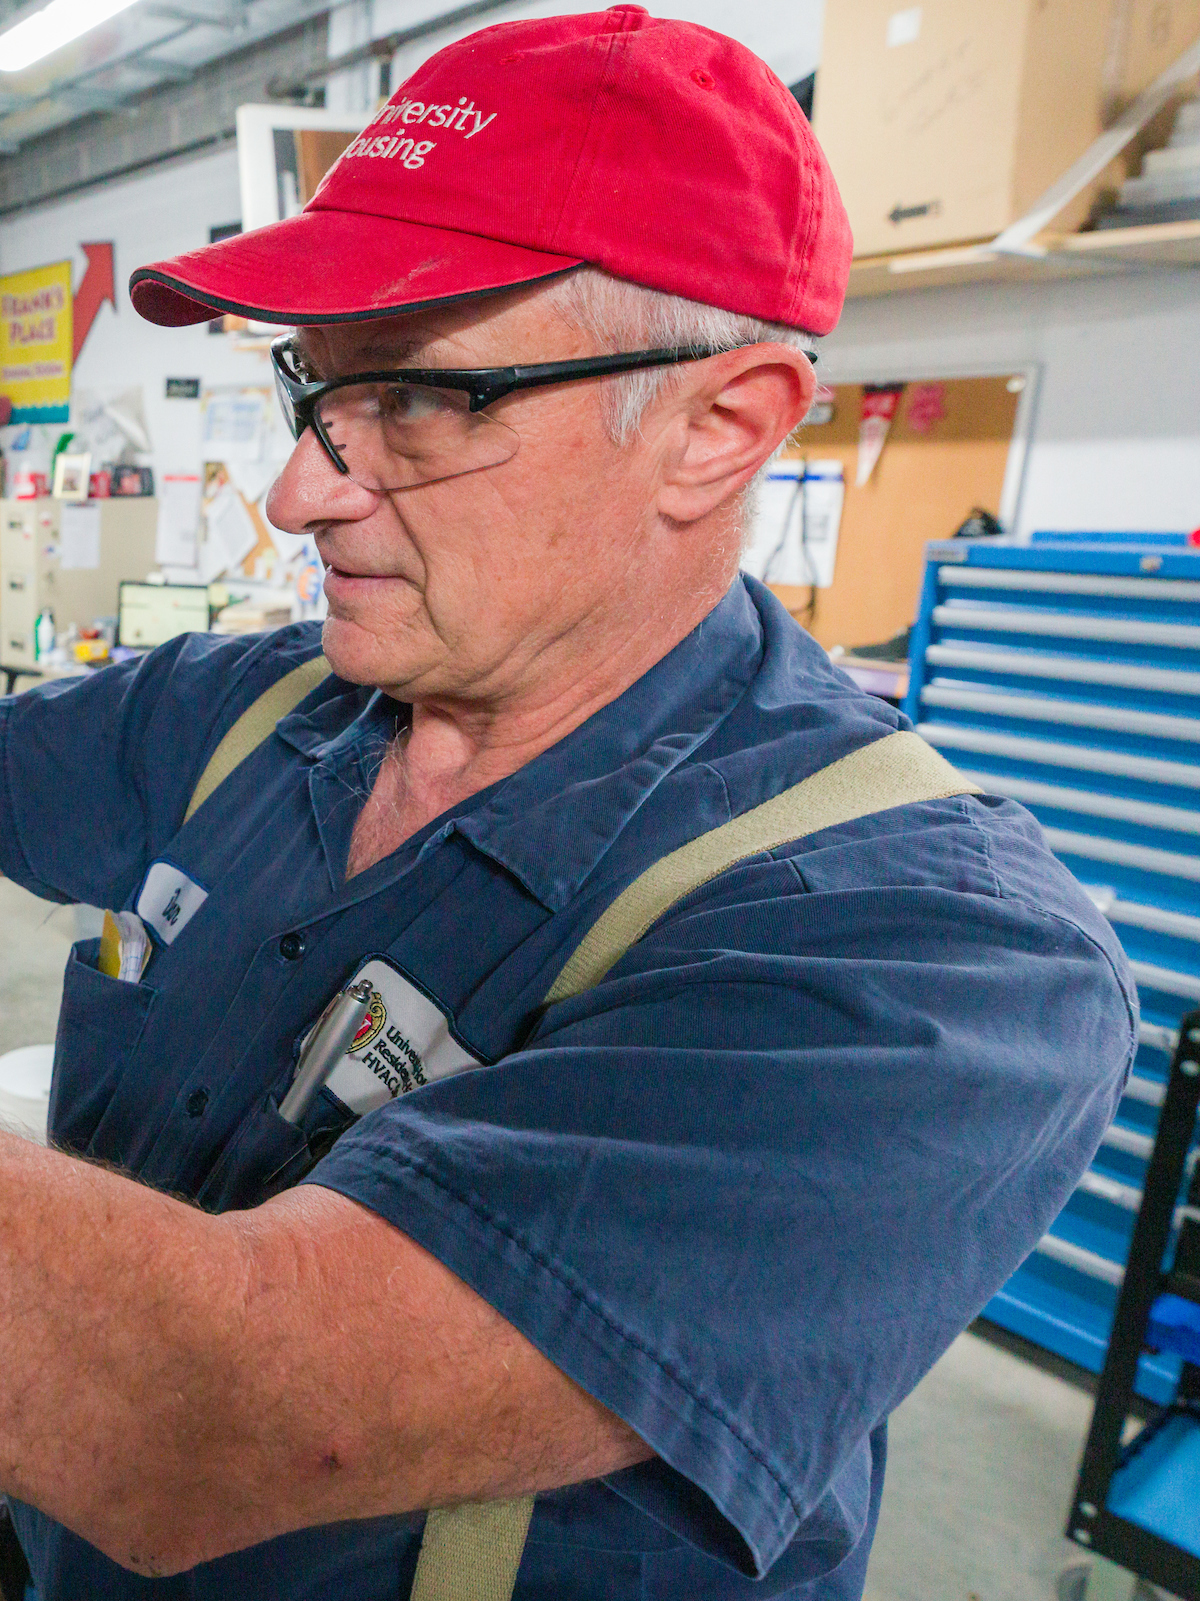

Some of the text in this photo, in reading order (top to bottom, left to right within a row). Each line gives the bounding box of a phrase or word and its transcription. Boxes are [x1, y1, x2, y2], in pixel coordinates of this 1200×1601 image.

[371, 96, 498, 139] niversity
[346, 128, 437, 169] ousing
[10, 317, 55, 343] PLACE
[362, 1051, 399, 1090] HVAC
